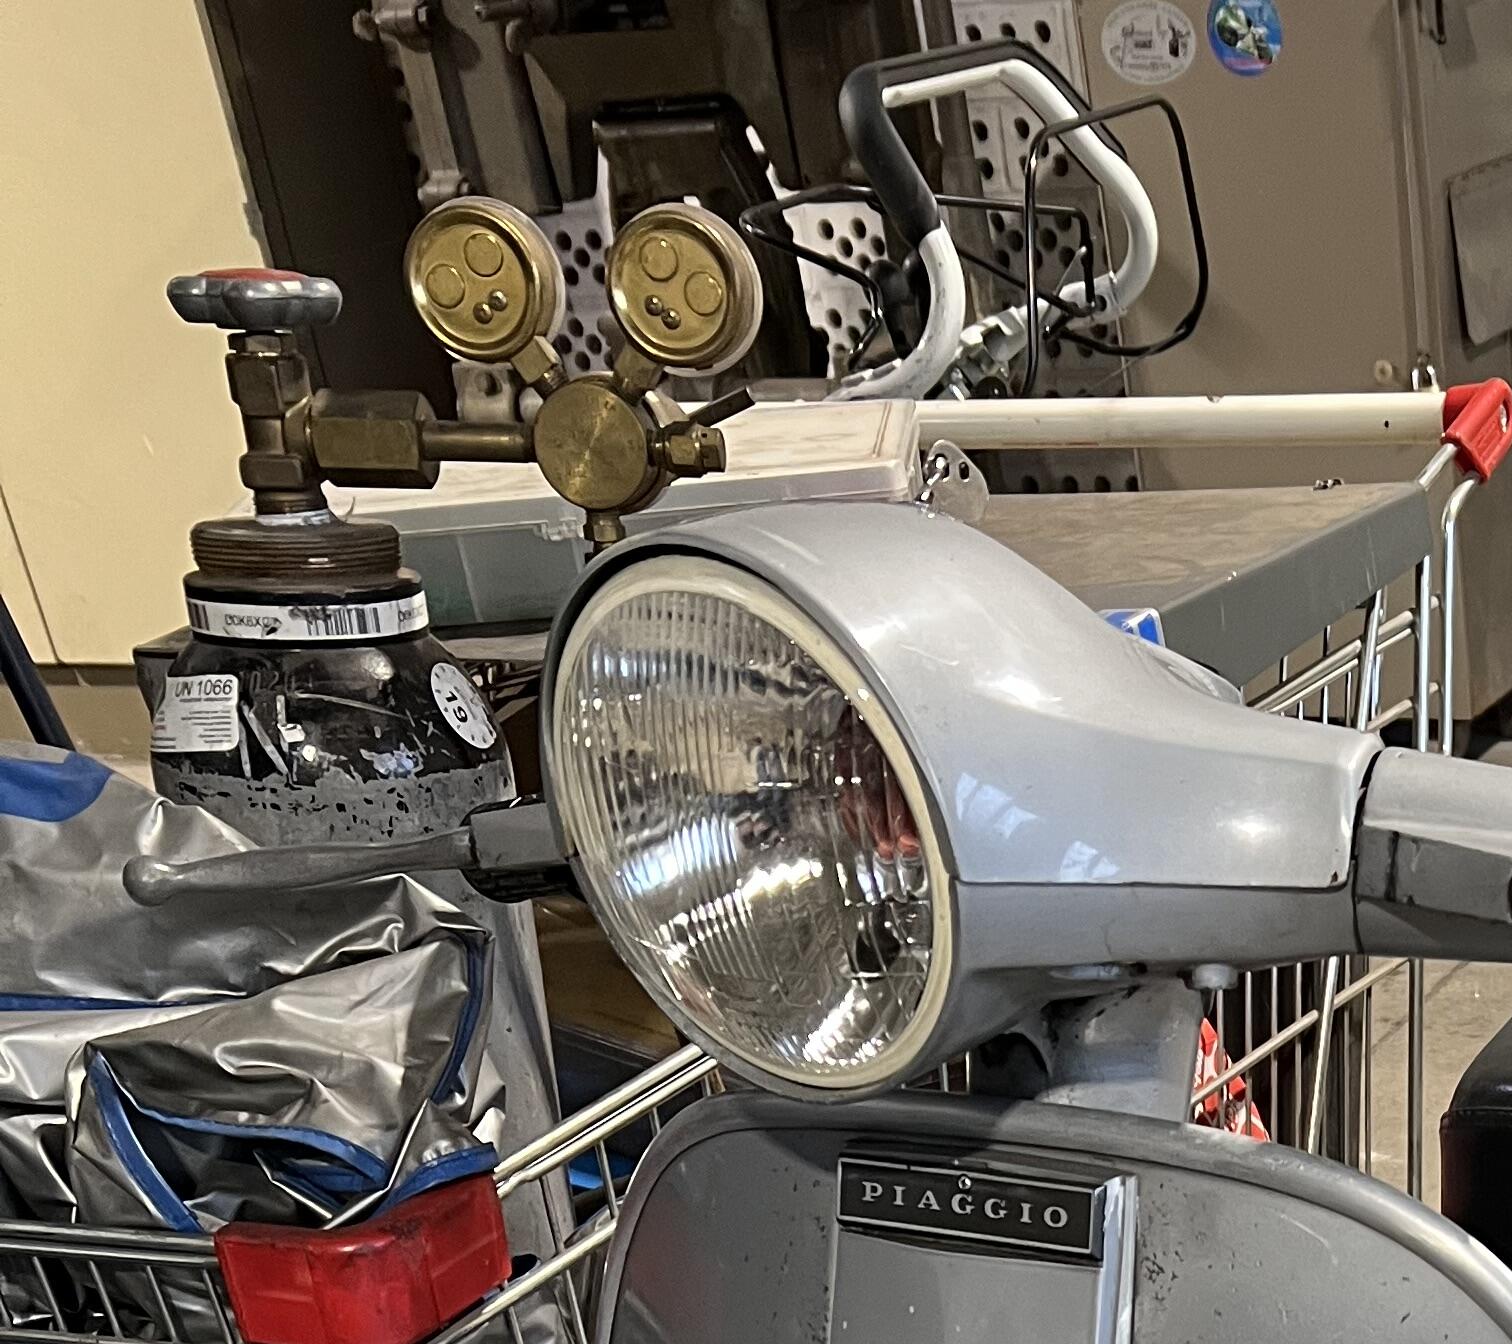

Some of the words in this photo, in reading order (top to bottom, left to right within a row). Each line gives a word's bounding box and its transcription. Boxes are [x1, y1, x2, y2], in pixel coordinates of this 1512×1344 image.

[174, 681, 192, 698] UN
[197, 678, 233, 697] 1066
[445, 690, 469, 723] 19
[861, 1180, 1069, 1228] PIAGGIO
